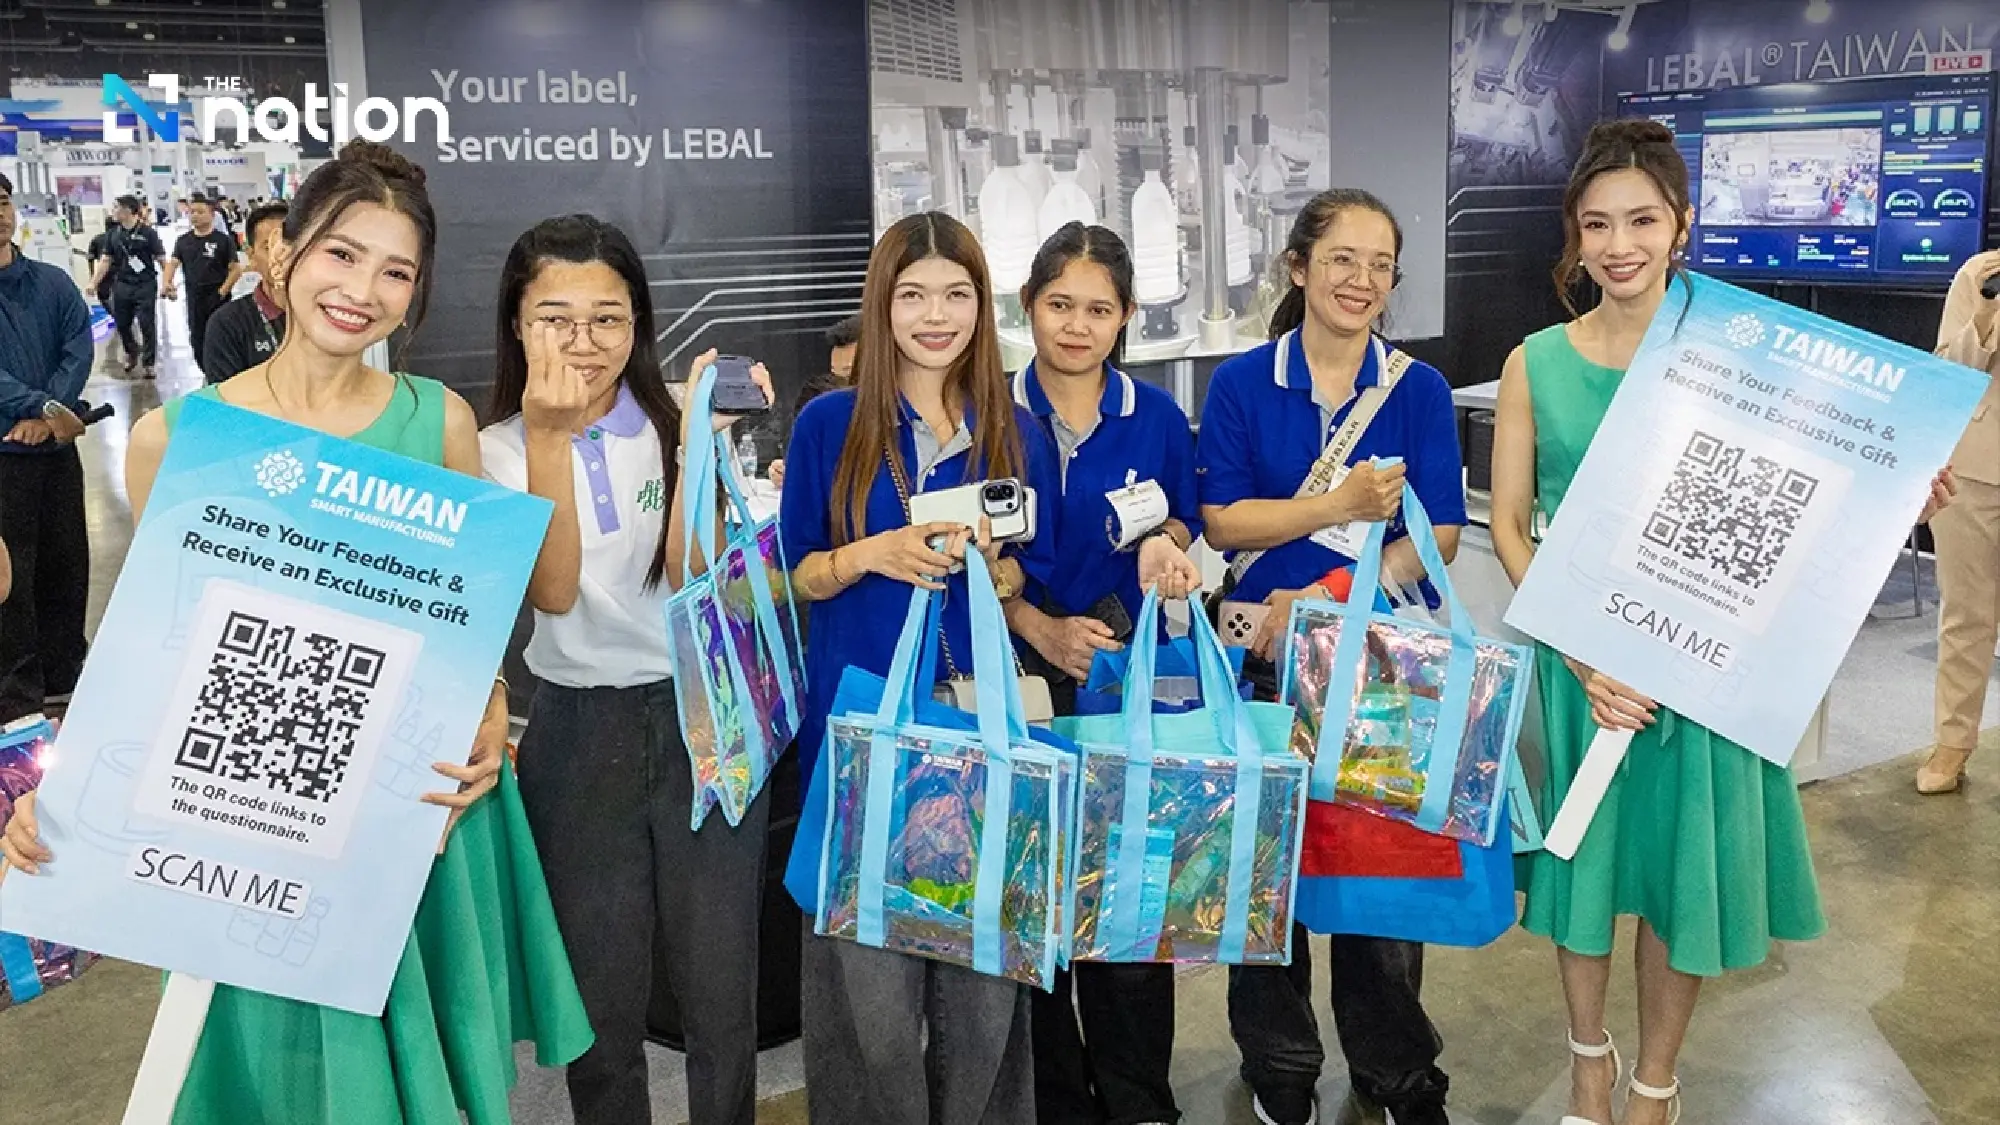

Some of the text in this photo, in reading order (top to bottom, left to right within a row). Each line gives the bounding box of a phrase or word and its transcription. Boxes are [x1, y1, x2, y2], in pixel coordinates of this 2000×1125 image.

[1791, 23, 1972, 80] TAIWAN
[430, 69, 638, 107] Your label,
[437, 128, 773, 168] serviced by LEBAL
[1772, 325, 1907, 392] TAIWAN
[1663, 367, 1898, 469] Receive an Exclusive Gift
[1679, 350, 1896, 443] Share Your Feedback &
[310, 498, 456, 548] SMART MANUFACTURING
[314, 461, 468, 533] TAIWAN
[182, 530, 470, 627] Receive an Exclusive Gift
[202, 504, 464, 593] Share Your Feedback &
[1637, 545, 1755, 606] The QR code links to
[1636, 561, 1741, 617] the questionnaire.
[1605, 592, 1731, 668] SCAN ME
[171, 775, 327, 826] The QR code links to
[171, 798, 309, 843] the questionnaire.
[134, 847, 303, 914] SCAN ME
